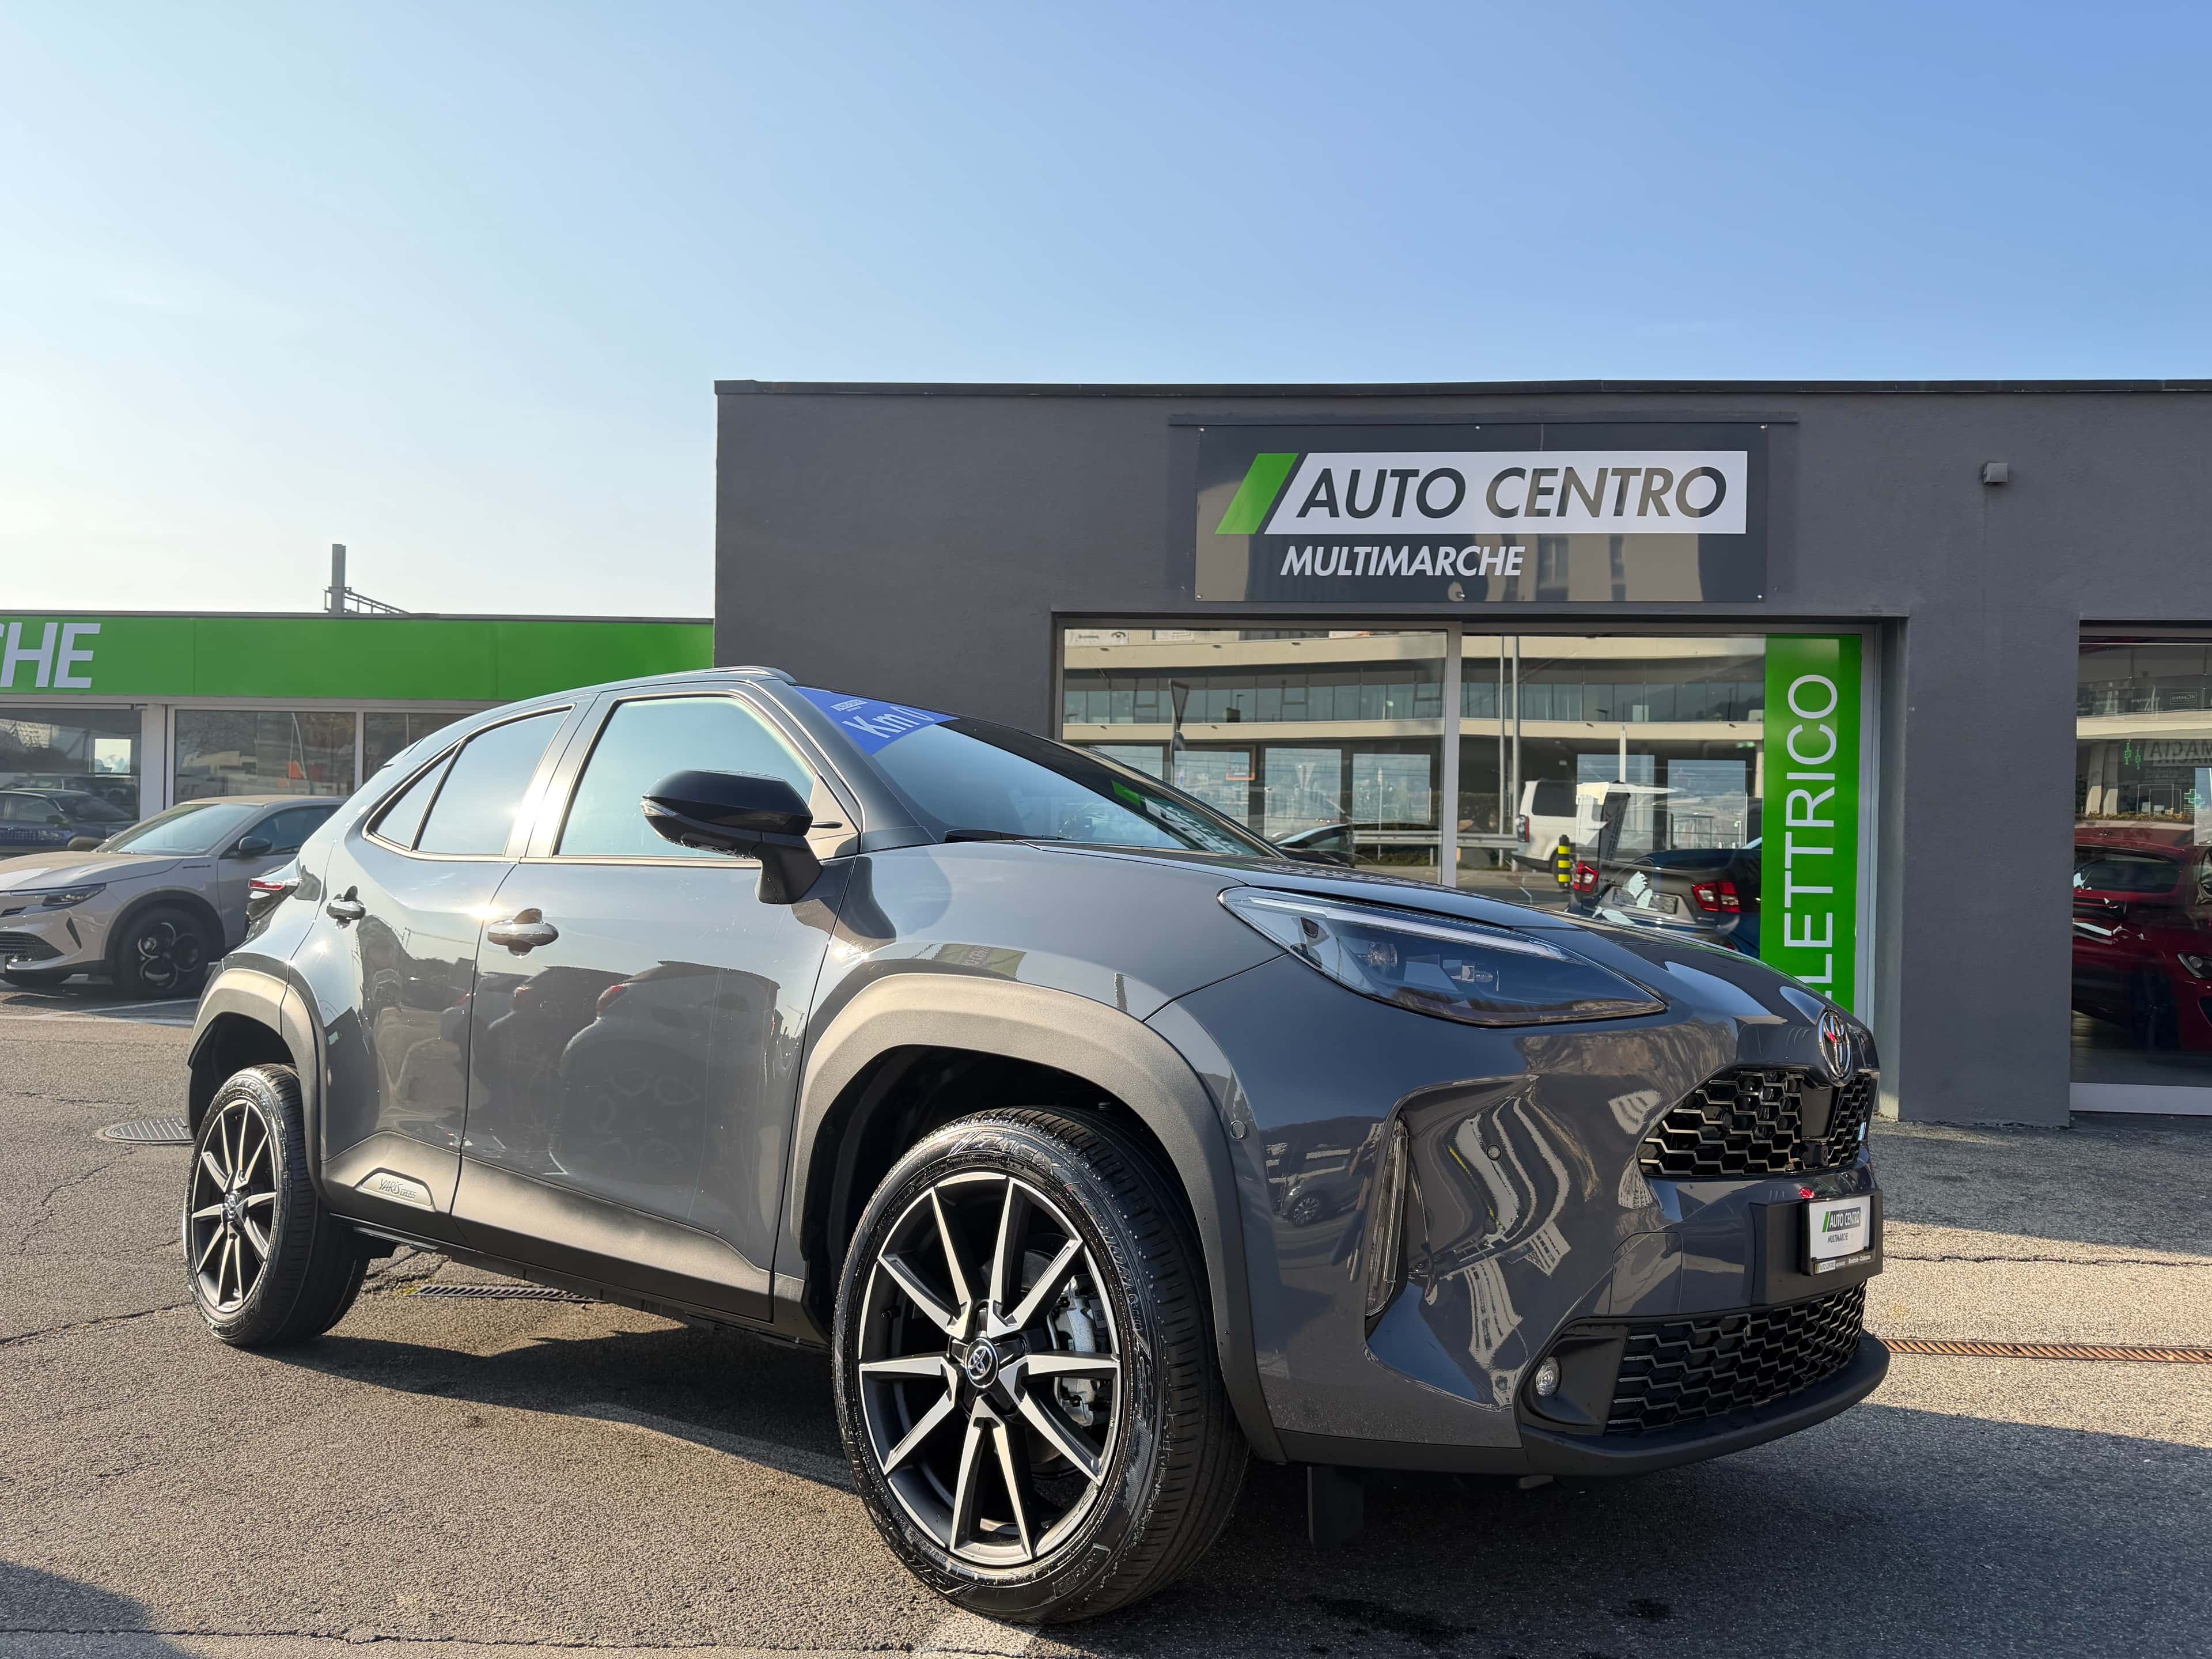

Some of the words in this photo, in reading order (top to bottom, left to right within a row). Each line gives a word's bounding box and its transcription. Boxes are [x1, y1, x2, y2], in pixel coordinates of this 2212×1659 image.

[1296, 466, 1466, 520] AUTO
[1485, 465, 1728, 519] CENTRO
[1280, 544, 1526, 577] MULTIMARCHE
[0, 622, 101, 688] HE
[1783, 674, 1838, 1000] LETTRICO
[1830, 1213, 1843, 1228] AUTO
[1844, 1211, 1860, 1226] CENTRO
